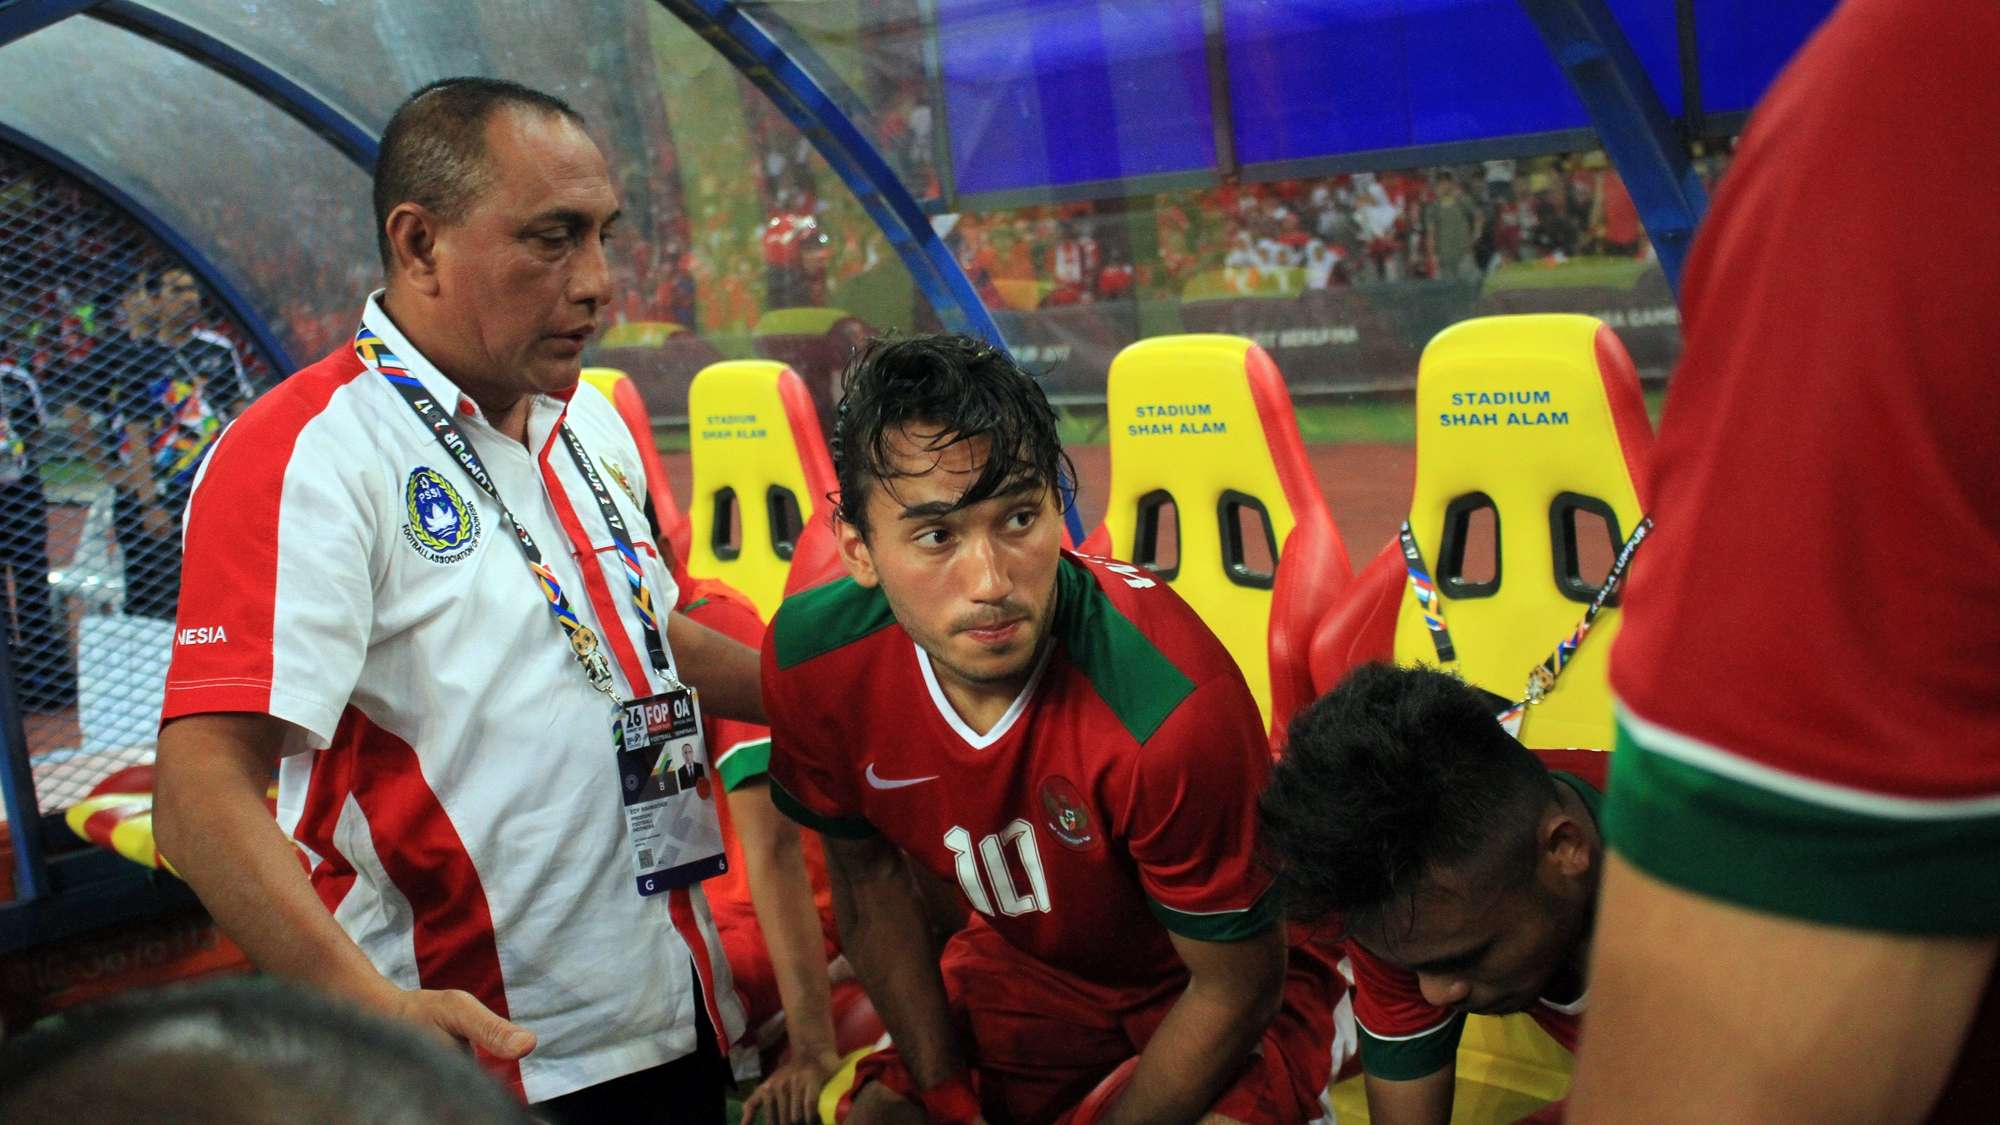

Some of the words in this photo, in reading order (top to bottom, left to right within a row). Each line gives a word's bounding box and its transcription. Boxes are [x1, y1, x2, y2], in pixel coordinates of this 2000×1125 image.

[1452, 391, 1551, 406] STADIUM
[1136, 404, 1212, 417] STADIUM
[1439, 413, 1498, 427] SHAH
[1507, 412, 1569, 426] ALAM
[1128, 424, 1173, 436] SHAH
[1180, 423, 1227, 435] ALAM
[444, 430, 493, 493] LUMPUR
[418, 487, 441, 504] PSSI
[402, 524, 430, 560] FOOTBALL
[430, 547, 475, 564] ASSOCIATION
[178, 626, 227, 645] NESIA
[626, 706, 642, 729] 26
[645, 704, 669, 726] FOP
[674, 696, 690, 719] OA
[944, 818, 1051, 917] 10
[645, 879, 655, 891] G
